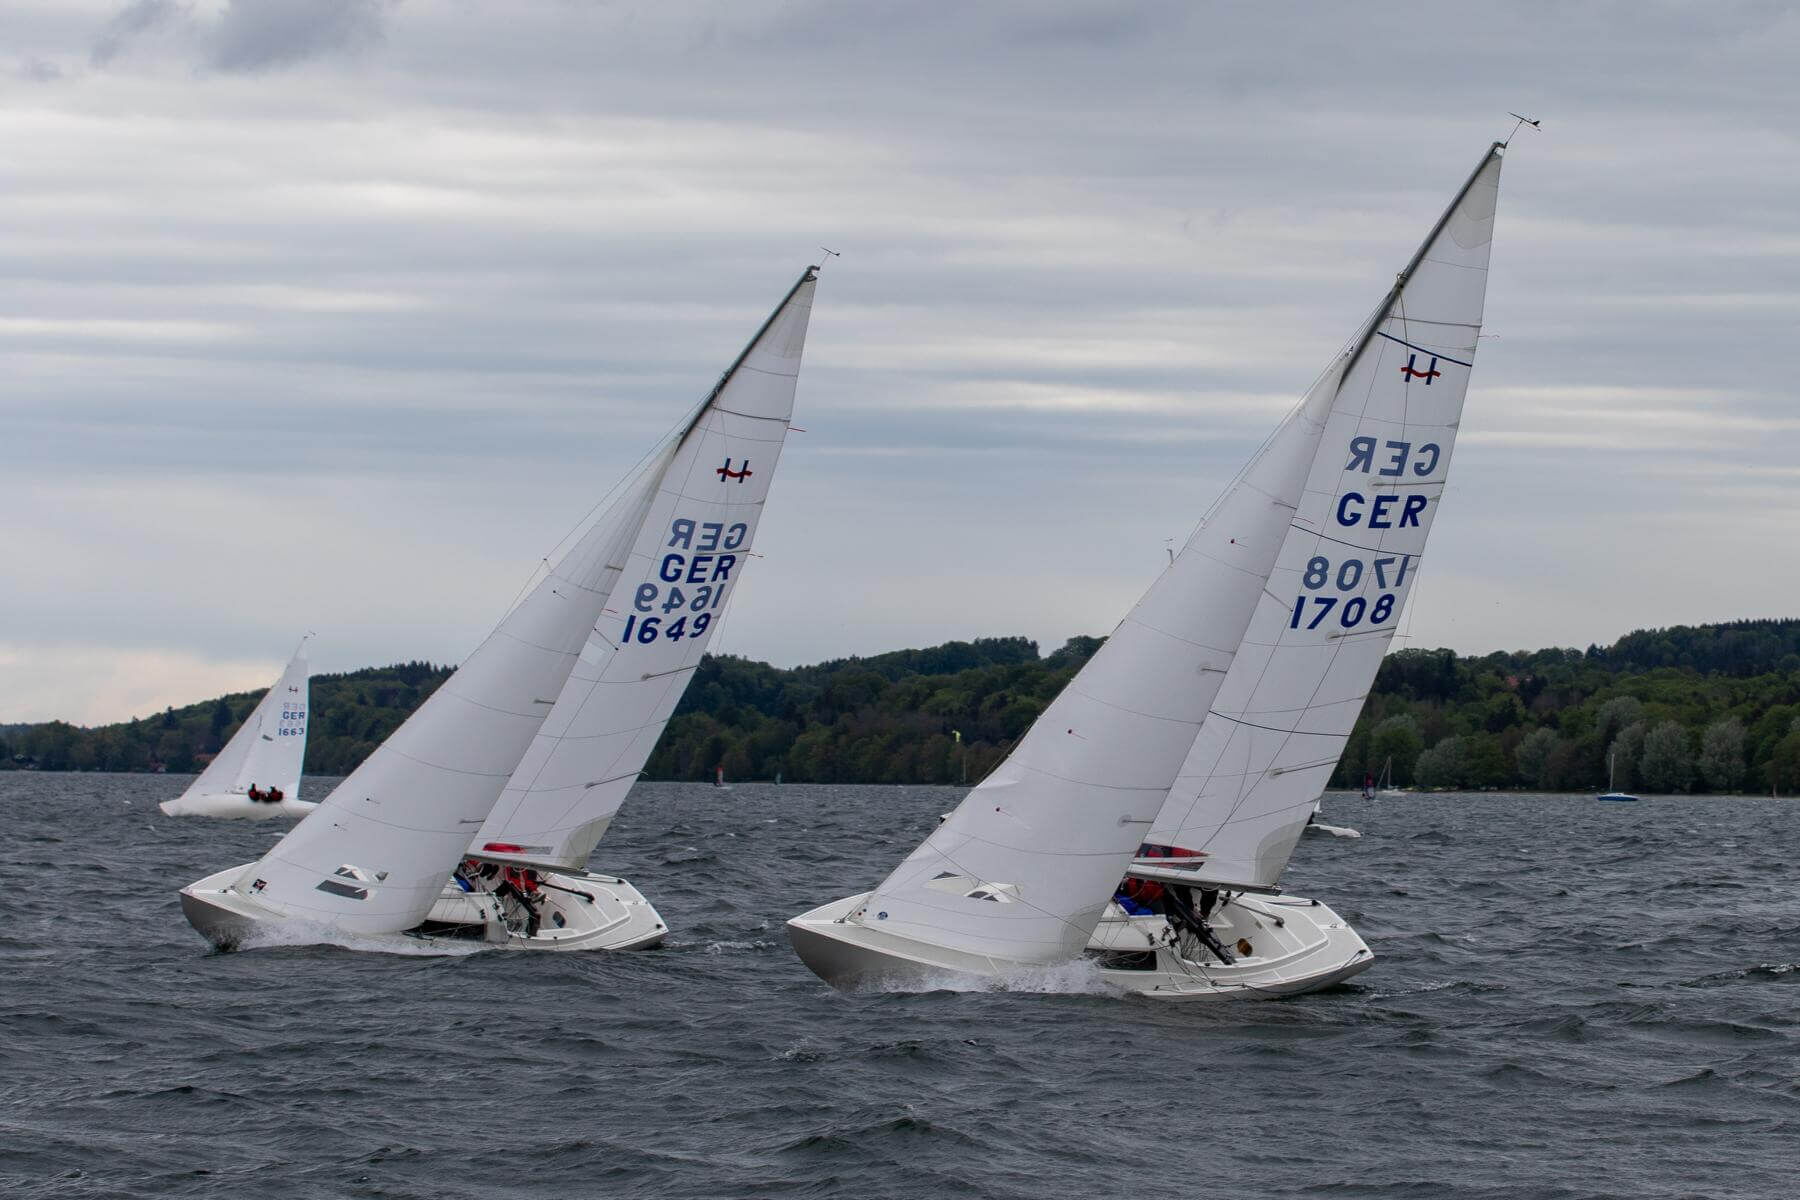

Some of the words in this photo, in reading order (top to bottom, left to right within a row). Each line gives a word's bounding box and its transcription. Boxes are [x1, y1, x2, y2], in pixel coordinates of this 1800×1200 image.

[1337, 492, 1427, 528] GER
[659, 553, 736, 583] GER
[1290, 594, 1395, 630] 1708
[622, 613, 711, 644] 1649
[283, 711, 305, 720] GER
[279, 728, 304, 736] 1663
